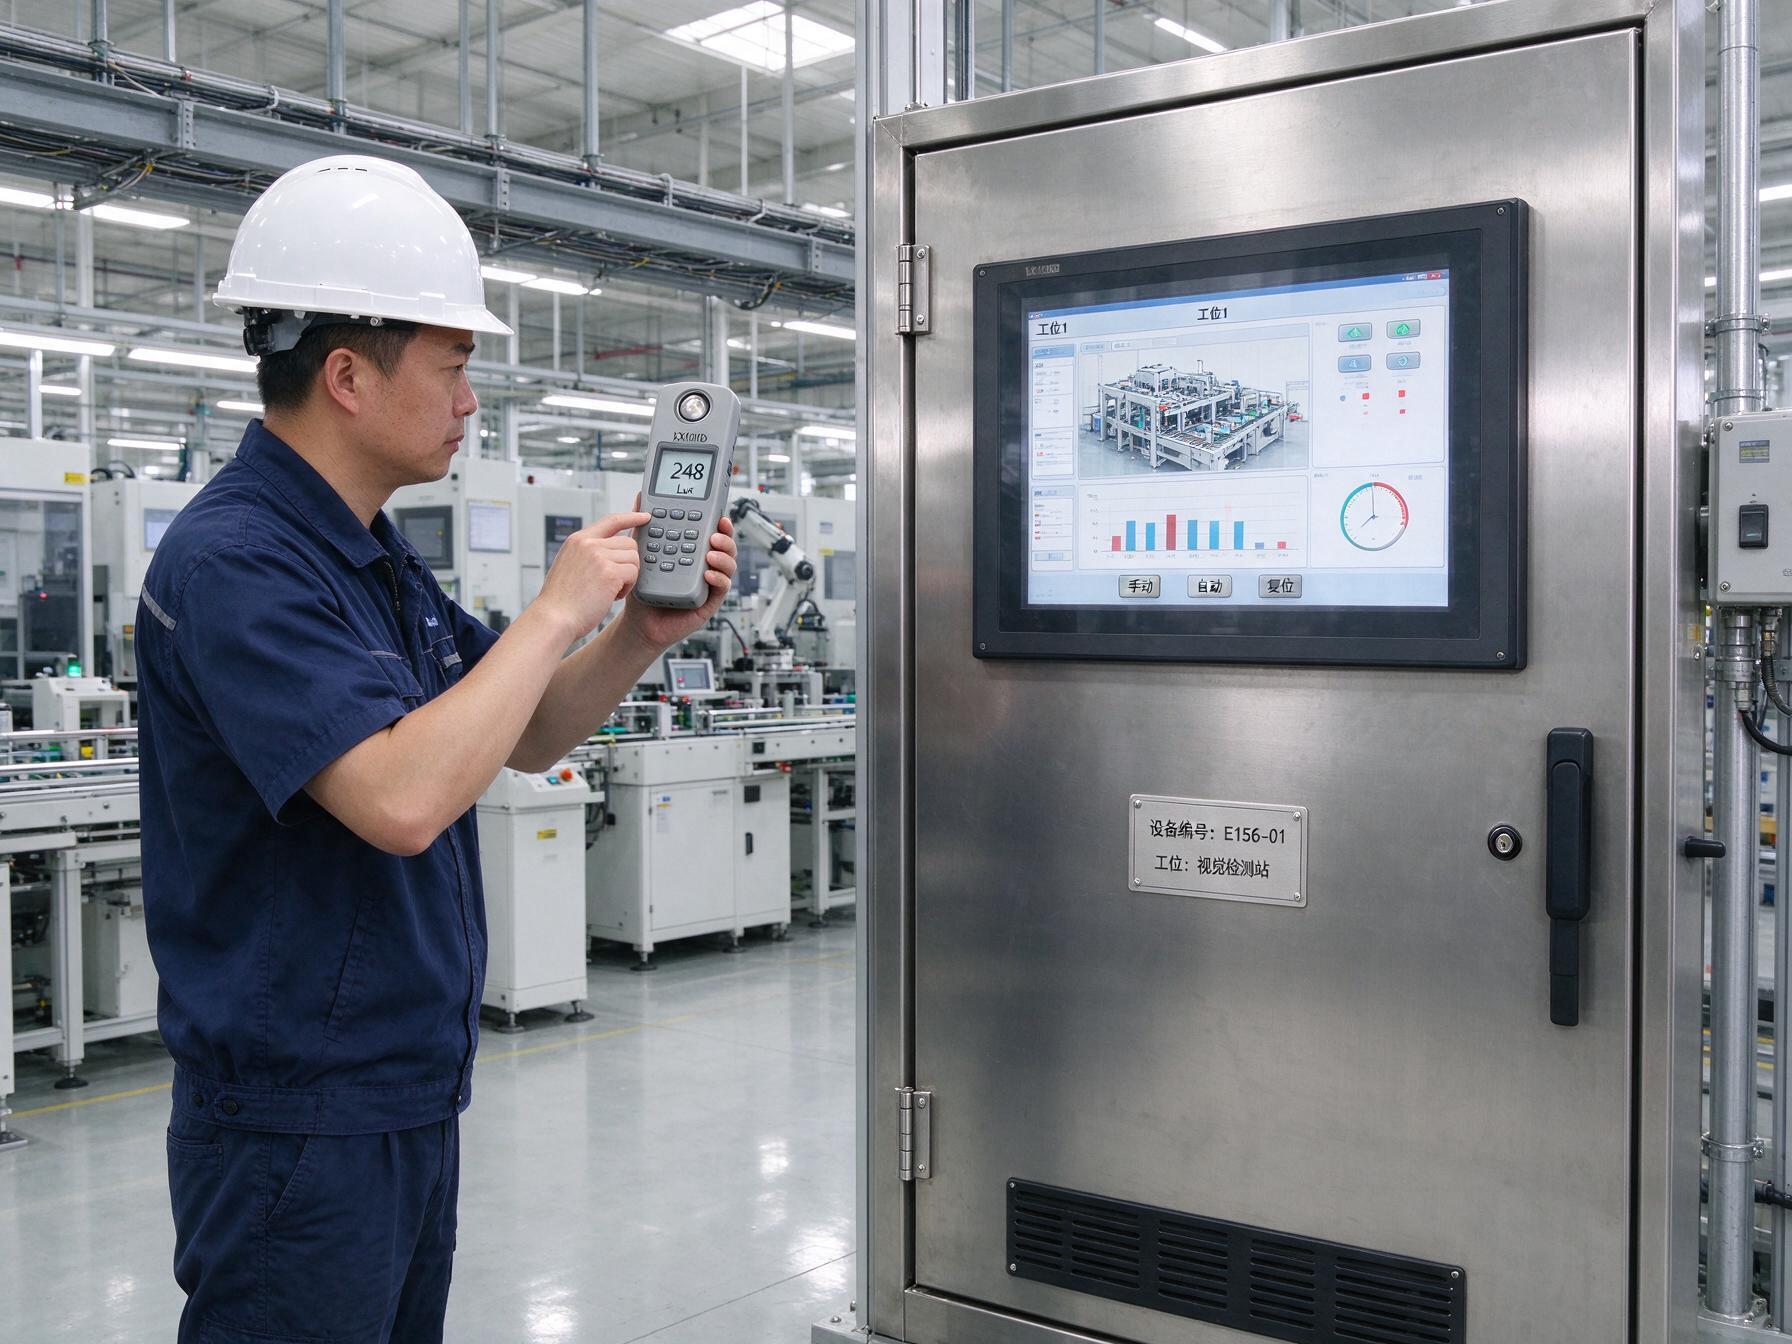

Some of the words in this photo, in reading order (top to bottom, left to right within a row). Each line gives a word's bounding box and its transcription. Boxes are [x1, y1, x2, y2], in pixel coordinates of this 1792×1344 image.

[1197, 306, 1228, 321] 工位1
[1035, 321, 1067, 336] 工位1
[670, 462, 705, 481] 248
[1127, 578, 1153, 594] 手动
[1198, 578, 1223, 594] 自动
[1267, 577, 1294, 594] 复位
